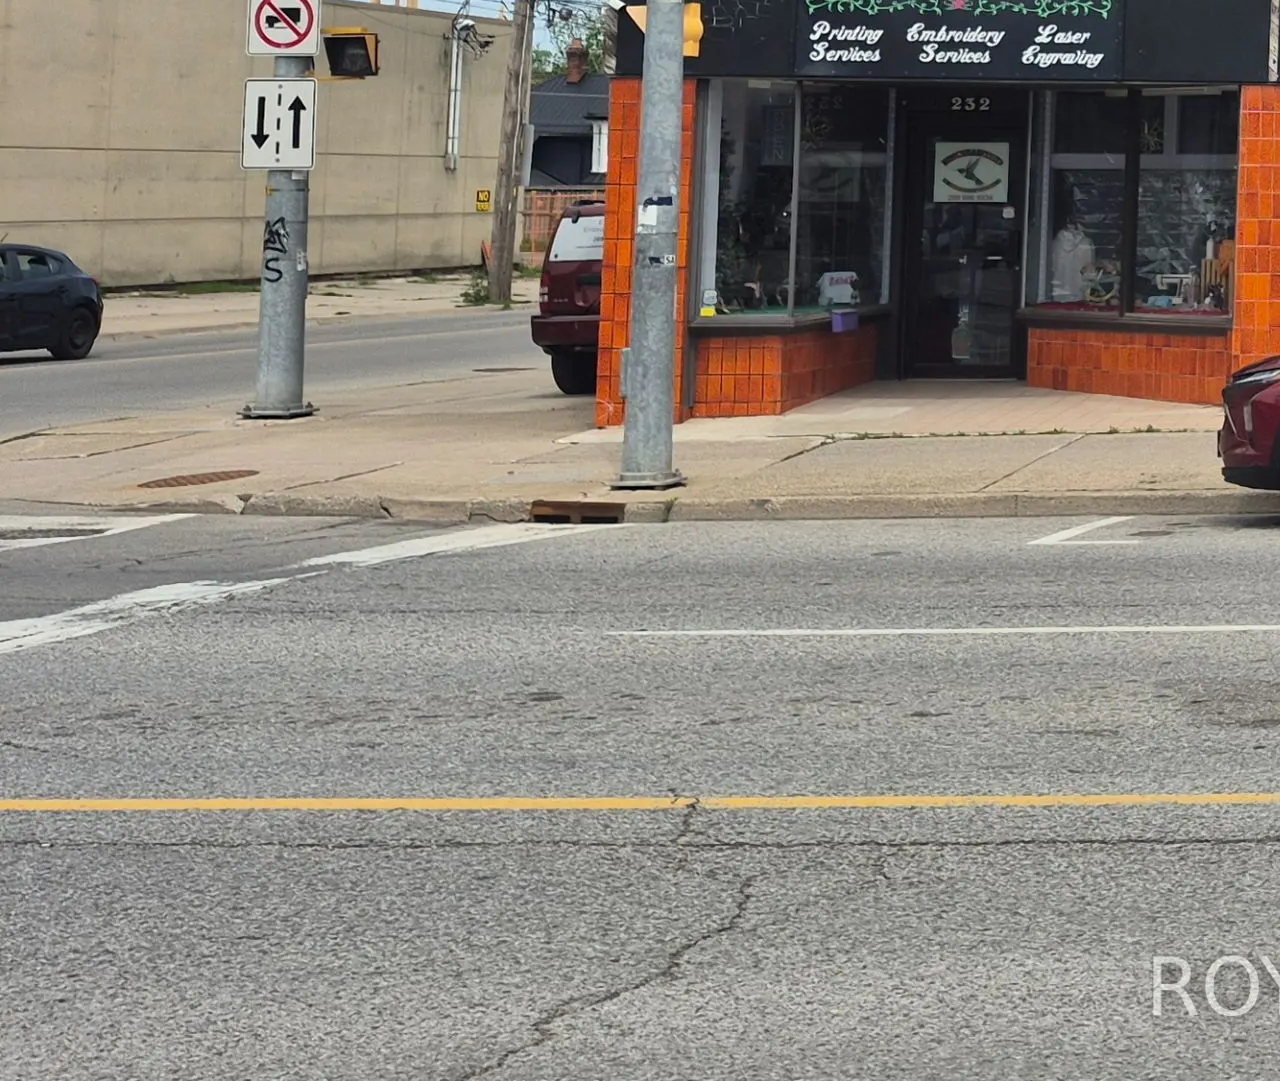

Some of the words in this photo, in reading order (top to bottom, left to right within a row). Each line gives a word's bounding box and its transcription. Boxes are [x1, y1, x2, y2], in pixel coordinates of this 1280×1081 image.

[809, 20, 884, 44] Printing
[906, 22, 1005, 47] Embroidery
[1034, 24, 1091, 45] Laser
[809, 42, 881, 63] Services
[919, 44, 991, 64] Services
[1021, 46, 1104, 68] Engraving
[951, 97, 990, 111] 232
[478, 191, 489, 201] NO
